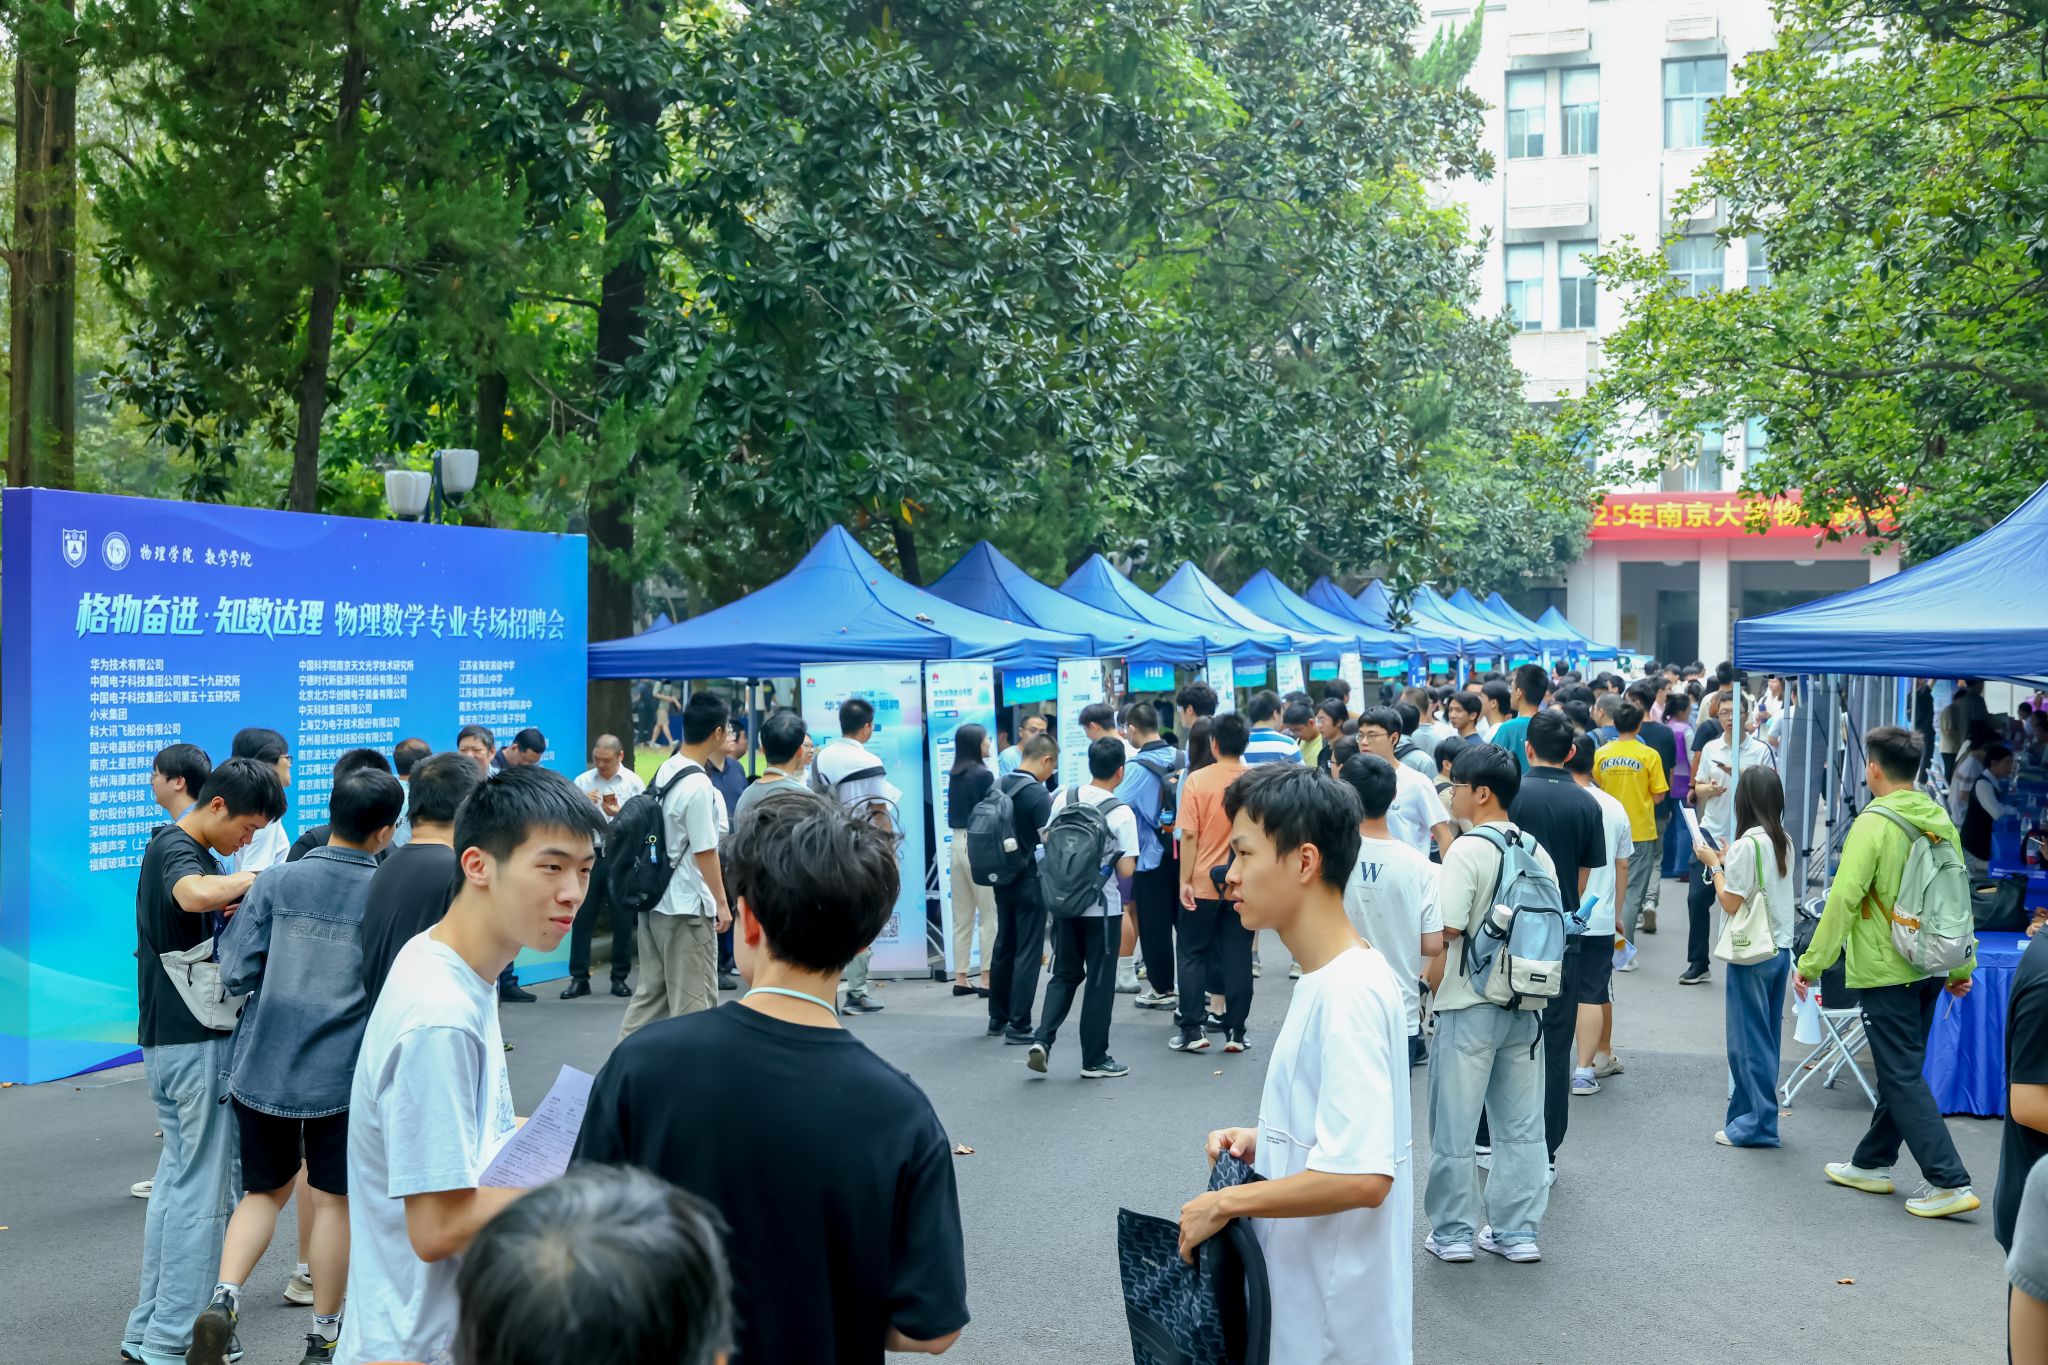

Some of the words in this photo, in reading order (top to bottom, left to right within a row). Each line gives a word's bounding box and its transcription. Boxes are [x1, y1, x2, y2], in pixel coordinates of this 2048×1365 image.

[140, 543, 194, 564] 物理学院
[334, 600, 565, 641] 物理数学专业专场招聘会
[90, 658, 164, 671] 华为技术有限公司
[298, 660, 414, 671] 中国科学院南京天文光学技术研究所
[90, 674, 241, 688] 中国电子科技集团公司第二十九研究所
[298, 674, 408, 686] 宁德时代新能源科技股份有限公司
[90, 690, 241, 704] 中国电子科技集团公司第五十五研究所
[298, 688, 407, 701] 北京北方华创微电子装备有限公司
[89, 707, 128, 721] 小米集团
[298, 703, 373, 716] 中天科技集团有限公司
[89, 722, 181, 738] 科大讯飞股份有限公司
[89, 806, 163, 822] 歌尔股份有限公司
[1361, 861, 1384, 883] W
